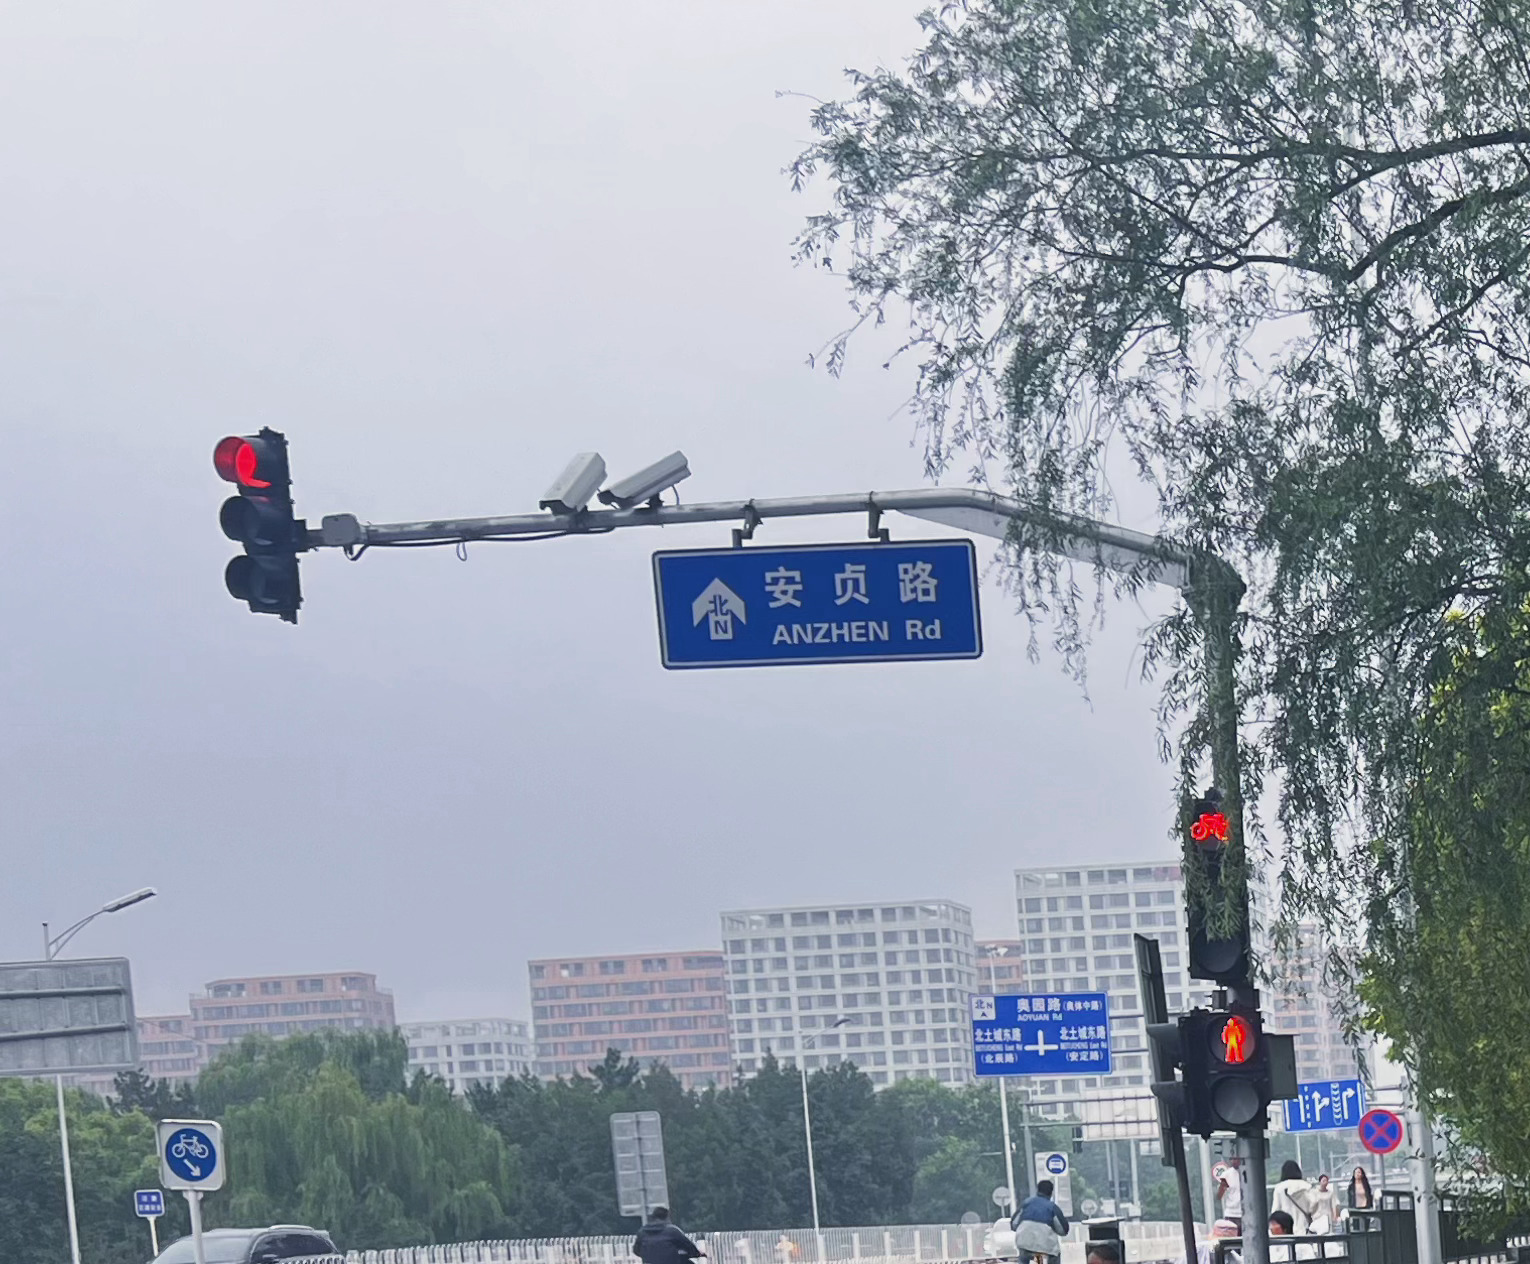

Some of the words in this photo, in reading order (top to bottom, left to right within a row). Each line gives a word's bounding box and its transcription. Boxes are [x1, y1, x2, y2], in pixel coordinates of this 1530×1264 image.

[764, 561, 938, 608] 安贞路
[708, 594, 729, 617] 北
[714, 619, 729, 635] N
[772, 621, 889, 645] ANZHEN
[905, 619, 942, 640] Rd
